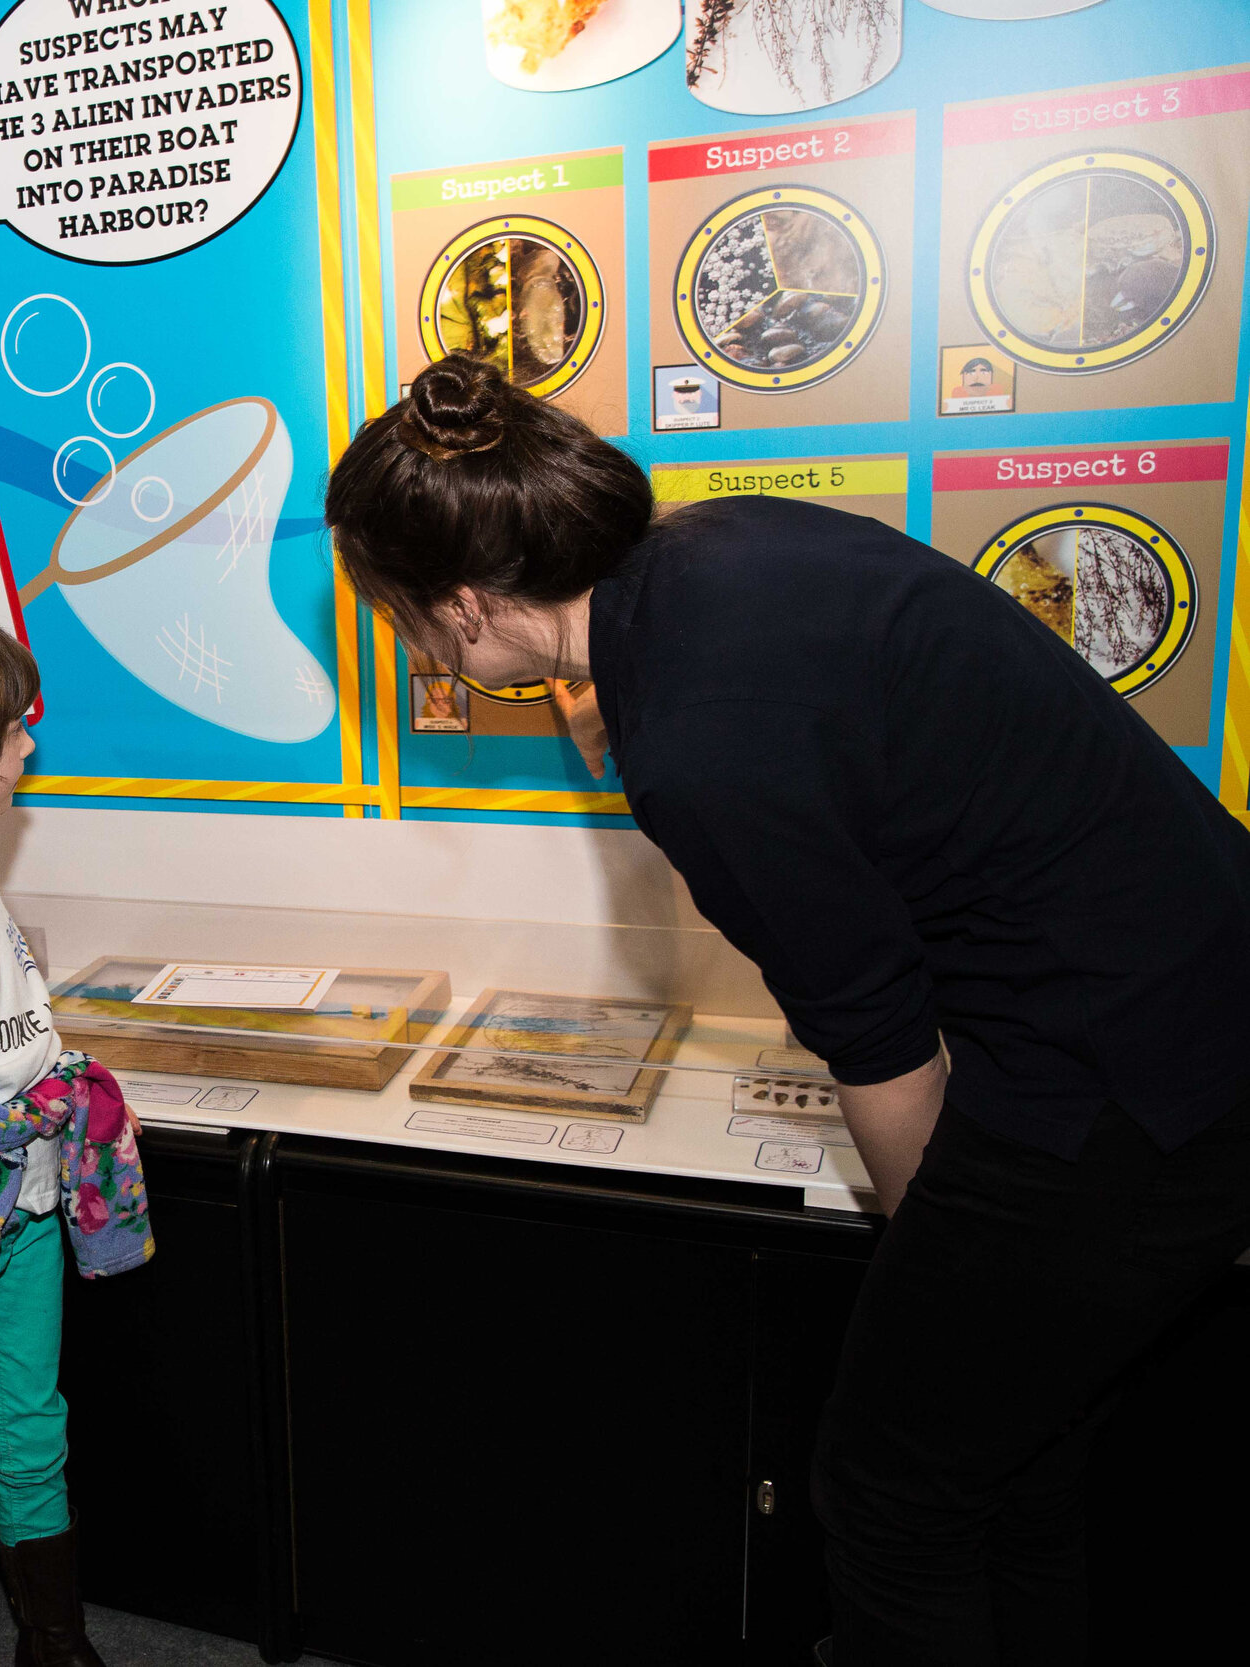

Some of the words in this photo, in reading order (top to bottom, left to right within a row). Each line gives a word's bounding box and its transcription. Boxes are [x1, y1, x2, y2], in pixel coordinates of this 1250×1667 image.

[19, 19, 152, 65] SUSPECTS
[159, 6, 227, 41] MAY
[64, 38, 274, 93] TRANSPORTED
[31, 113, 45, 136] 3
[51, 97, 134, 132] ALIEN
[140, 73, 291, 118] INVADERS
[1012, 92, 1149, 132] Suspect
[1161, 87, 1180, 114] 3
[23, 146, 63, 172] ON
[70, 133, 151, 166] THEIR
[158, 119, 238, 154] BOAT
[706, 135, 824, 170] Suspect
[833, 131, 849, 156] 2
[16, 178, 84, 209] INTO
[89, 158, 231, 200] PARADISE
[441, 166, 545, 200] Suspect
[552, 165, 569, 187] 1
[58, 198, 209, 239] HARBOUR?
[708, 468, 820, 496] Suspect
[829, 466, 845, 487] 5
[996, 453, 1126, 485] Suspect
[1137, 451, 1156, 474] 6
